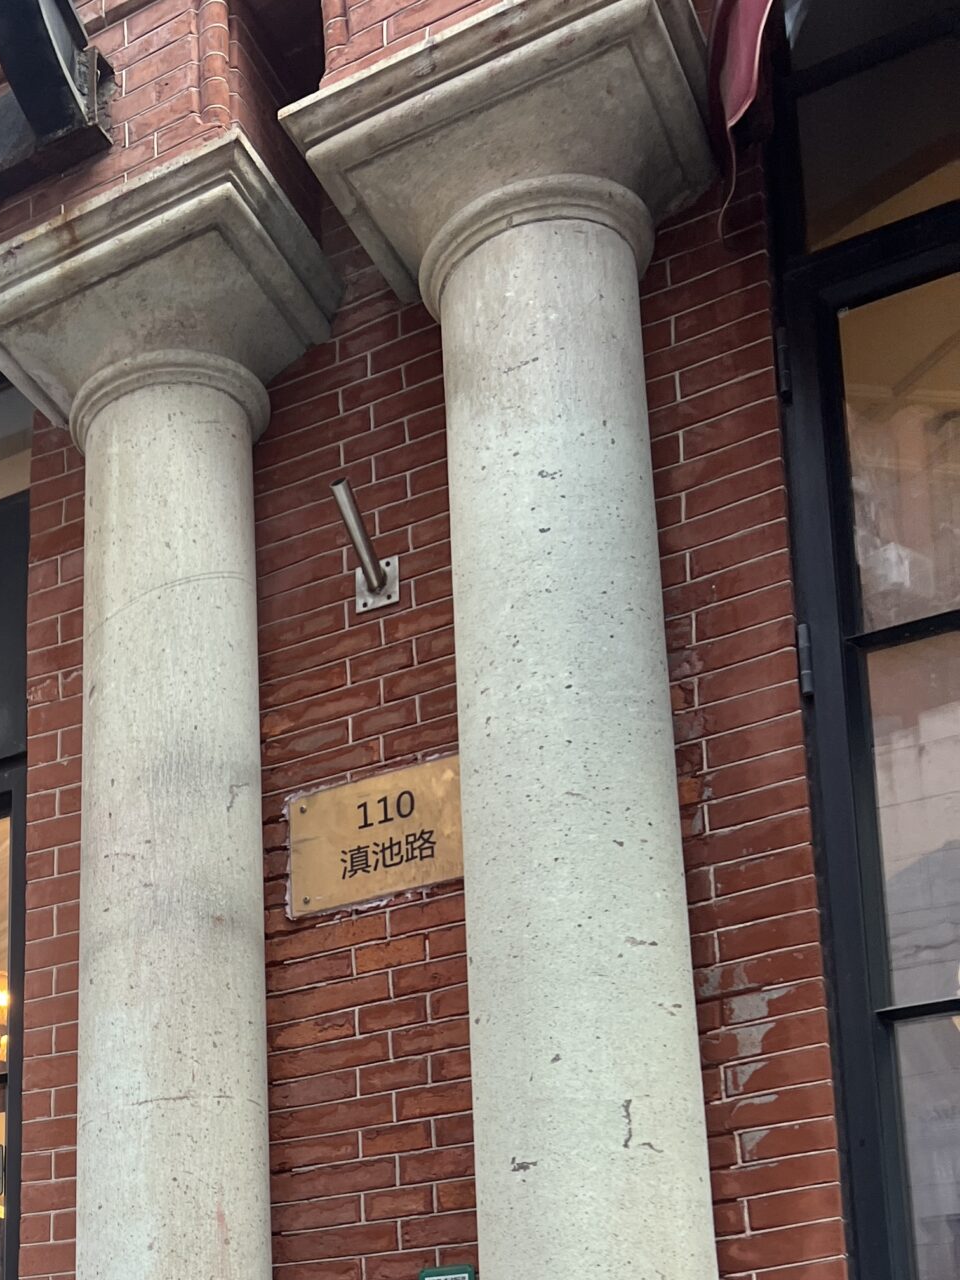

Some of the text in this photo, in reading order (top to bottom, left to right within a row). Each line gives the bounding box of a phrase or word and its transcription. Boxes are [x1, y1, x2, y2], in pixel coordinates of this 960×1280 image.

[357, 790, 415, 829] 110
[340, 828, 437, 880] 滇池路
